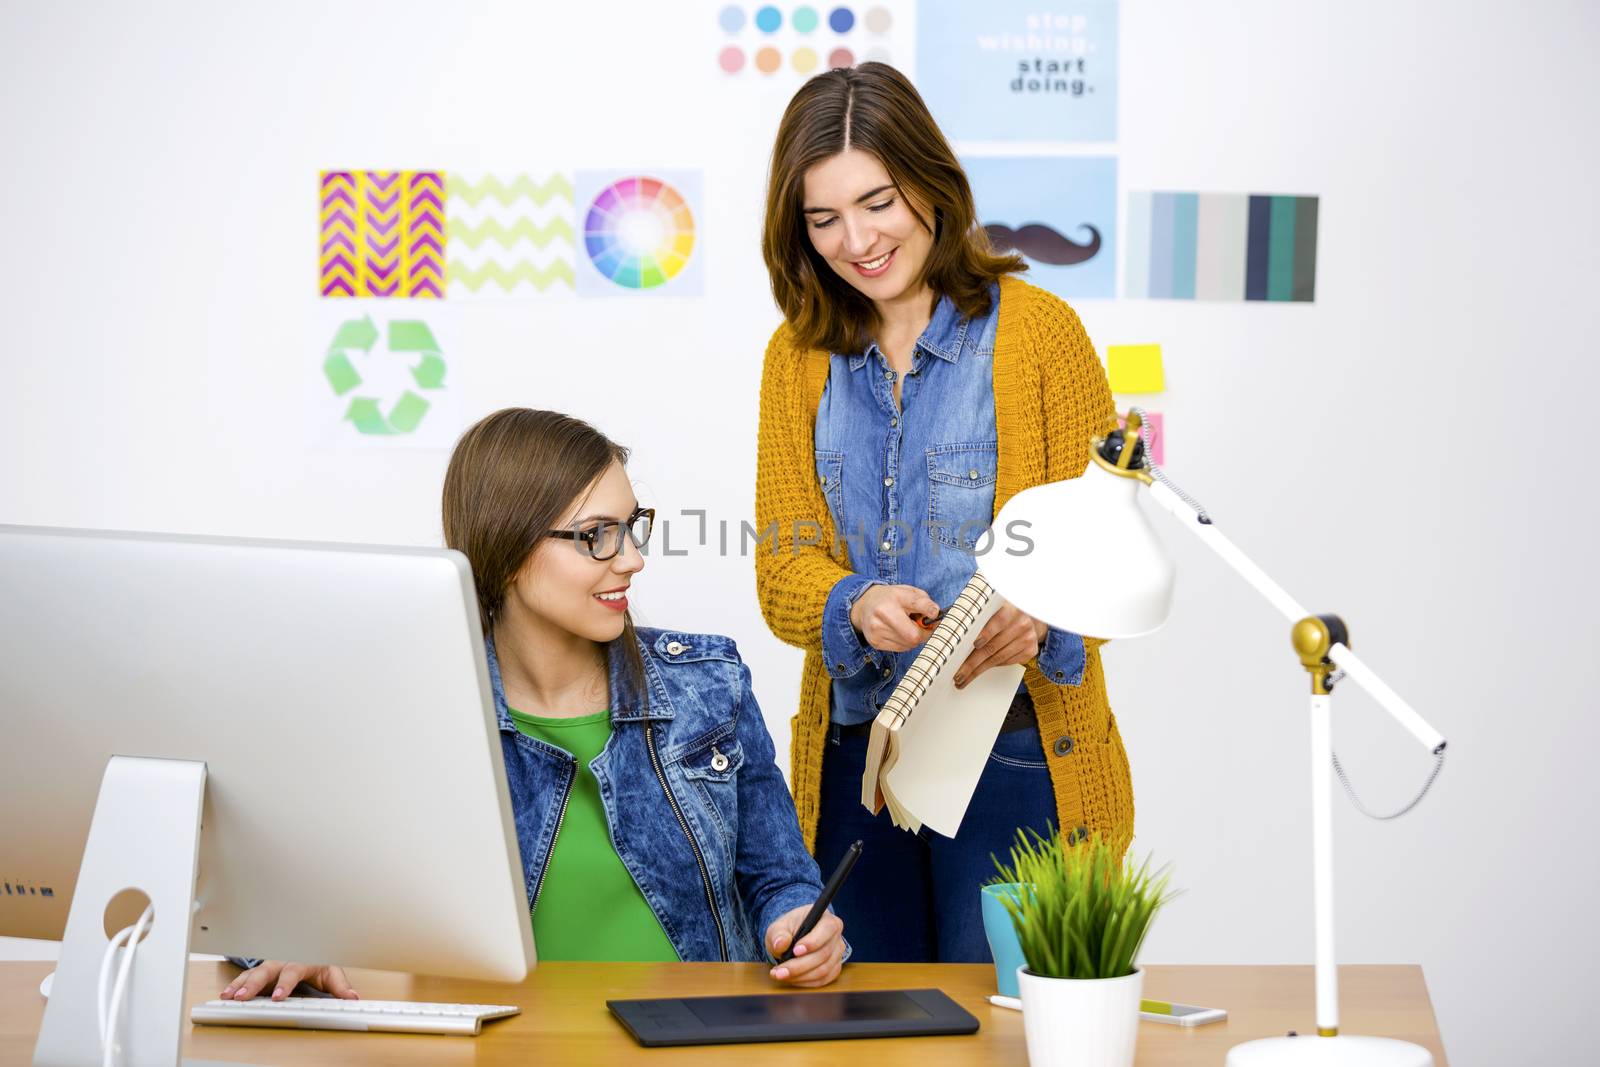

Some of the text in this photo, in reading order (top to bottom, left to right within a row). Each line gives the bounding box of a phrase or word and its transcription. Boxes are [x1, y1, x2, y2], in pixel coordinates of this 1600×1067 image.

[1026, 13, 1087, 32] stop
[977, 33, 1095, 53] wishing.
[1018, 57, 1085, 74] start
[1010, 75, 1095, 97] doing.
